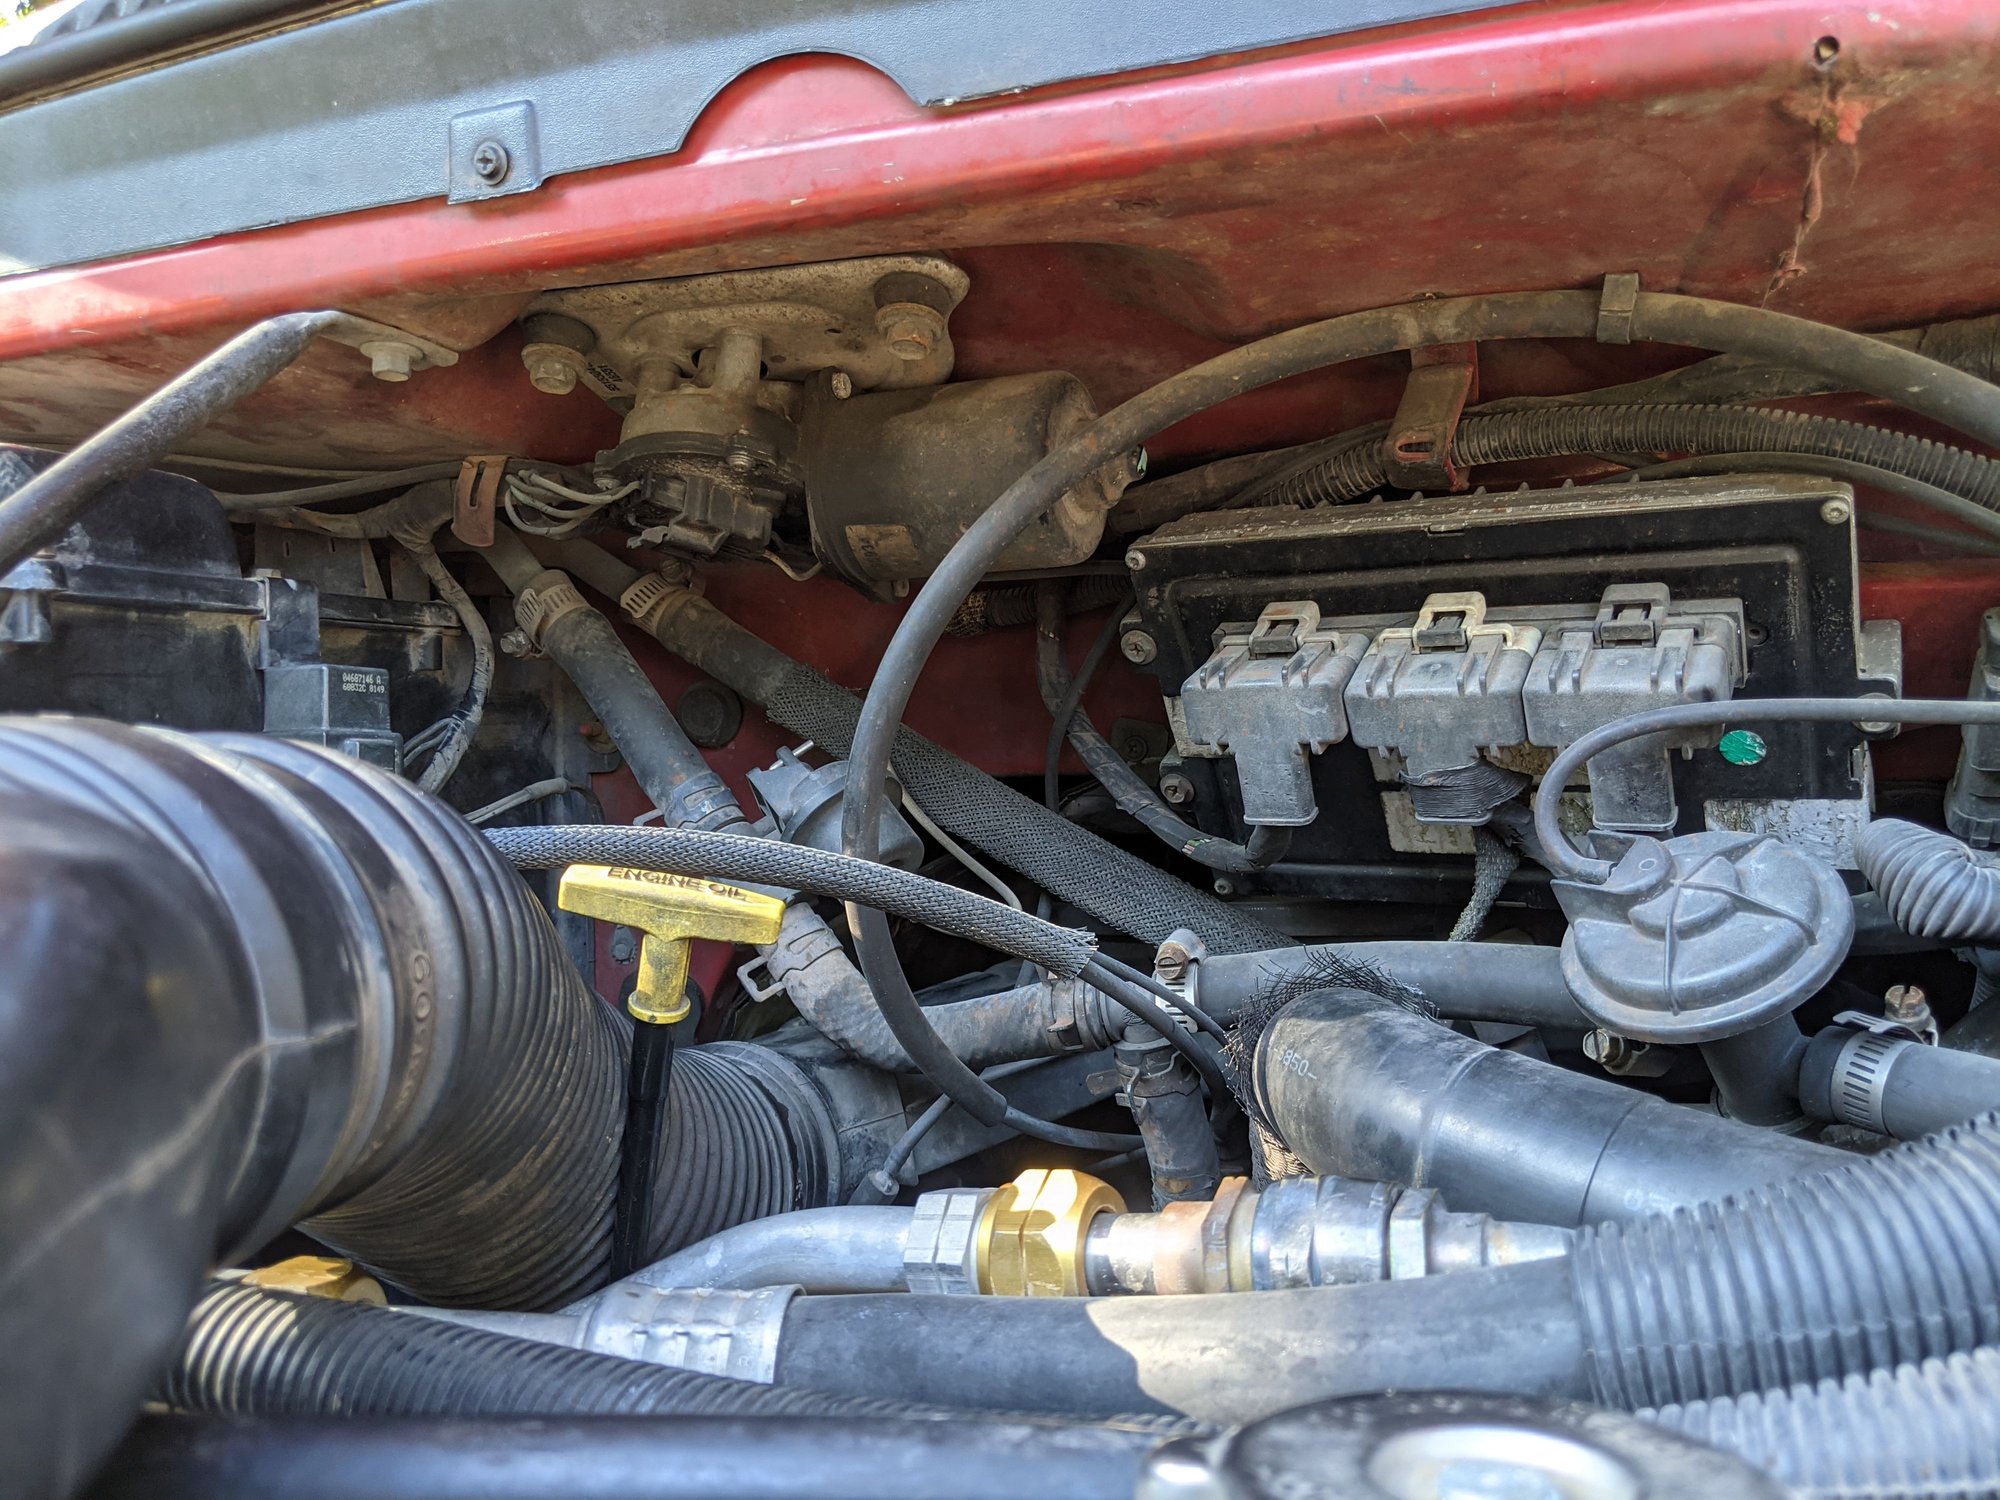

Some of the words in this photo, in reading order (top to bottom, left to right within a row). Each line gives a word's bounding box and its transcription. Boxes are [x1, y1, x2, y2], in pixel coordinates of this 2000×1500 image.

[376, 675, 382, 684] A
[369, 684, 385, 693] 8149
[608, 867, 705, 892] ENGINE
[708, 883, 747, 901] OIL
